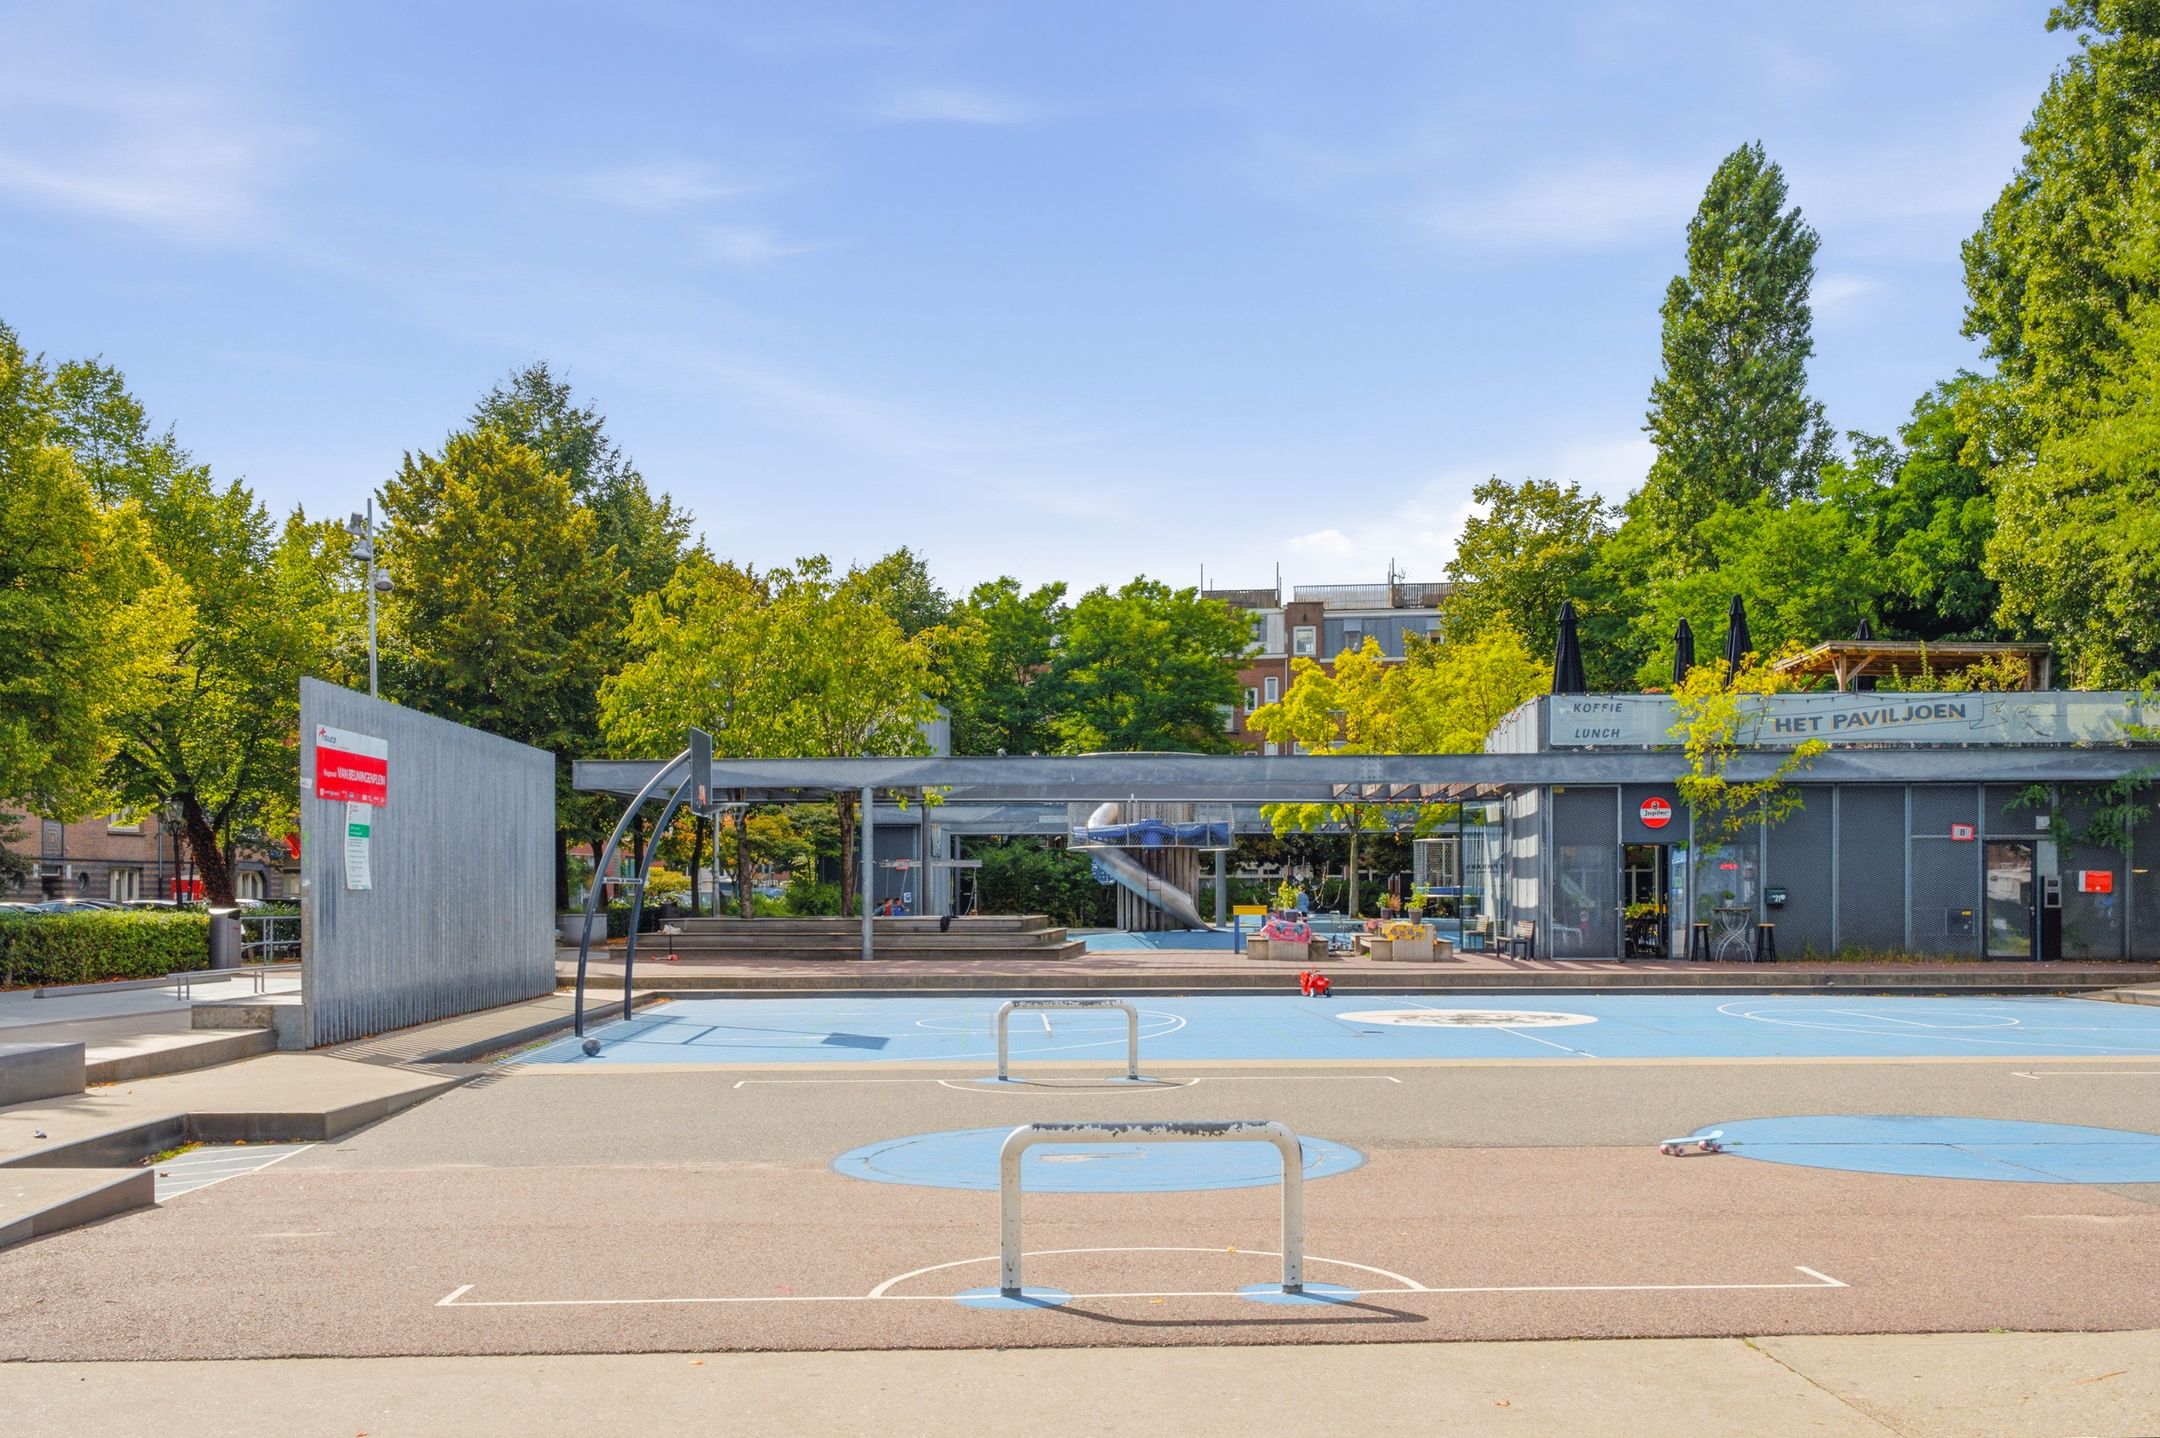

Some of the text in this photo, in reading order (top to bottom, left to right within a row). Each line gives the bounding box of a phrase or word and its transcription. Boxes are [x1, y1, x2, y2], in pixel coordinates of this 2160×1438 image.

[1573, 703, 1623, 713] KOFFIE
[1774, 703, 1967, 733] HET PAVILJOEN
[1574, 728, 1621, 739] LUNCH
